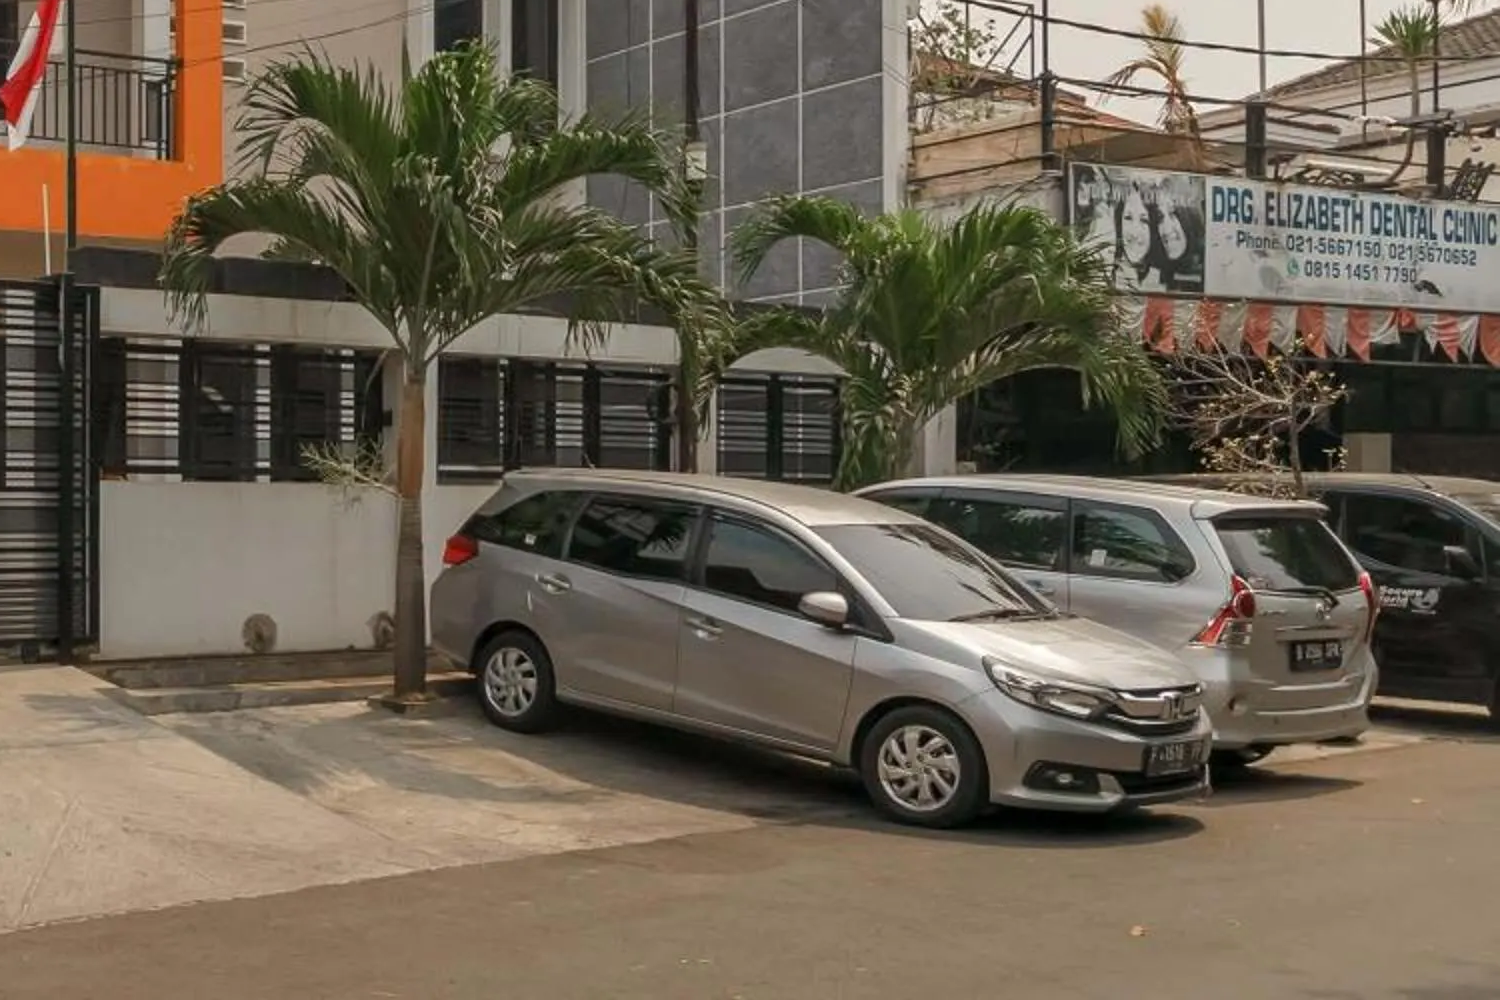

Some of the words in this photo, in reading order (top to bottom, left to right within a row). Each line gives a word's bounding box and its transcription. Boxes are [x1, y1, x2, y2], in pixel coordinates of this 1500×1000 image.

[1265, 191, 1364, 235] ELIZABETH
[1370, 202, 1437, 240] DENTAL
[1443, 209, 1498, 246] CLINIC
[1304, 260, 1340, 278] 0815
[1345, 263, 1379, 281] 1451
